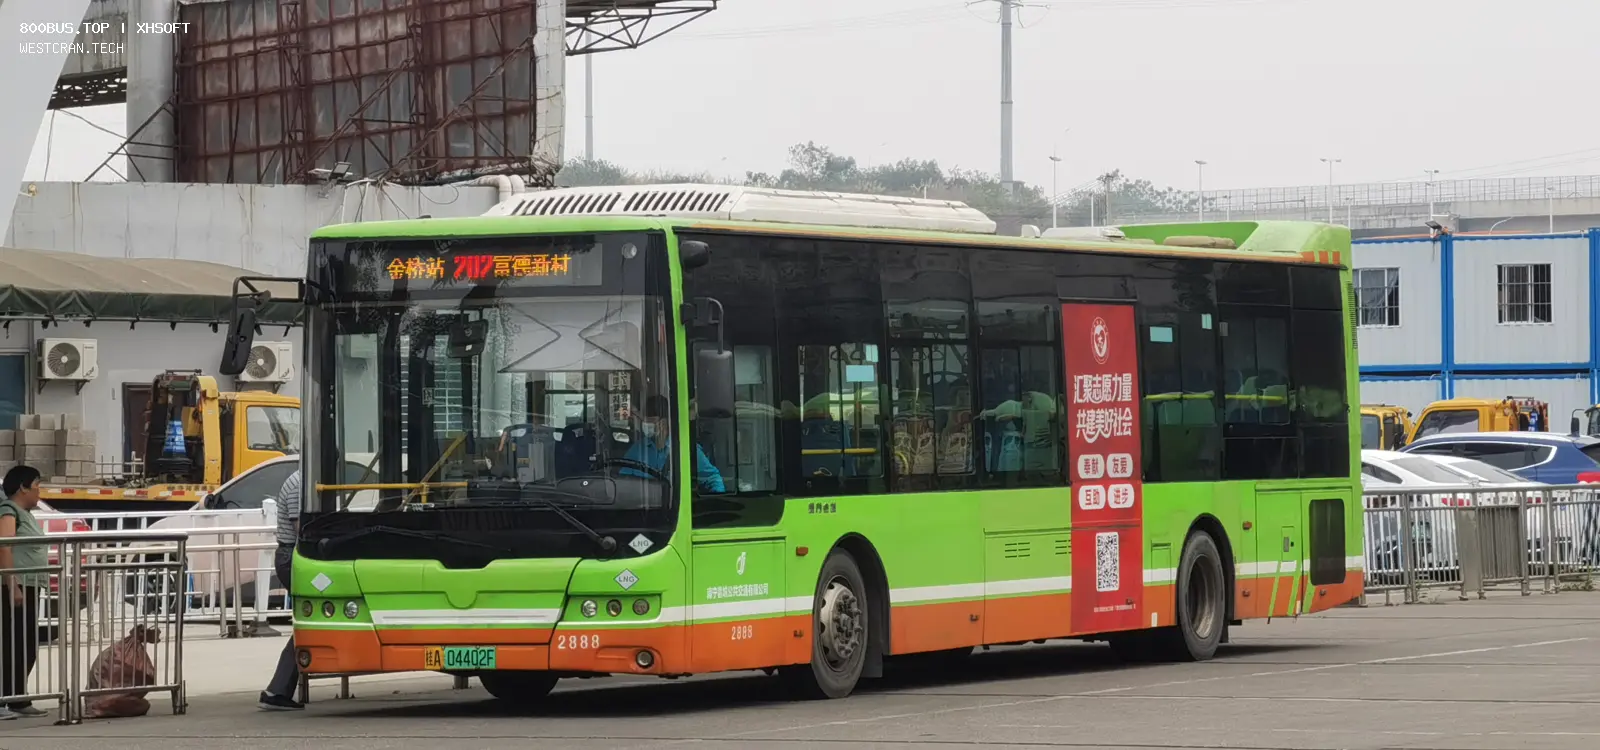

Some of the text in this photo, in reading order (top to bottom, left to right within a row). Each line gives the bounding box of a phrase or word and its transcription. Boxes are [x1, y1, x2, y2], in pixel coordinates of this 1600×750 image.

[386, 256, 445, 279] 金桥站
[492, 253, 572, 277] 富德新村
[1073, 373, 1133, 403] 汇聚志愿力量
[1076, 406, 1133, 443] 共建美好社会
[1084, 456, 1127, 475] 奉献 友爱
[1085, 488, 1128, 505] 互助 进步
[632, 539, 651, 548] LNG
[618, 574, 636, 583] LNG
[731, 624, 753, 640] 2888
[557, 634, 600, 650] 2888
